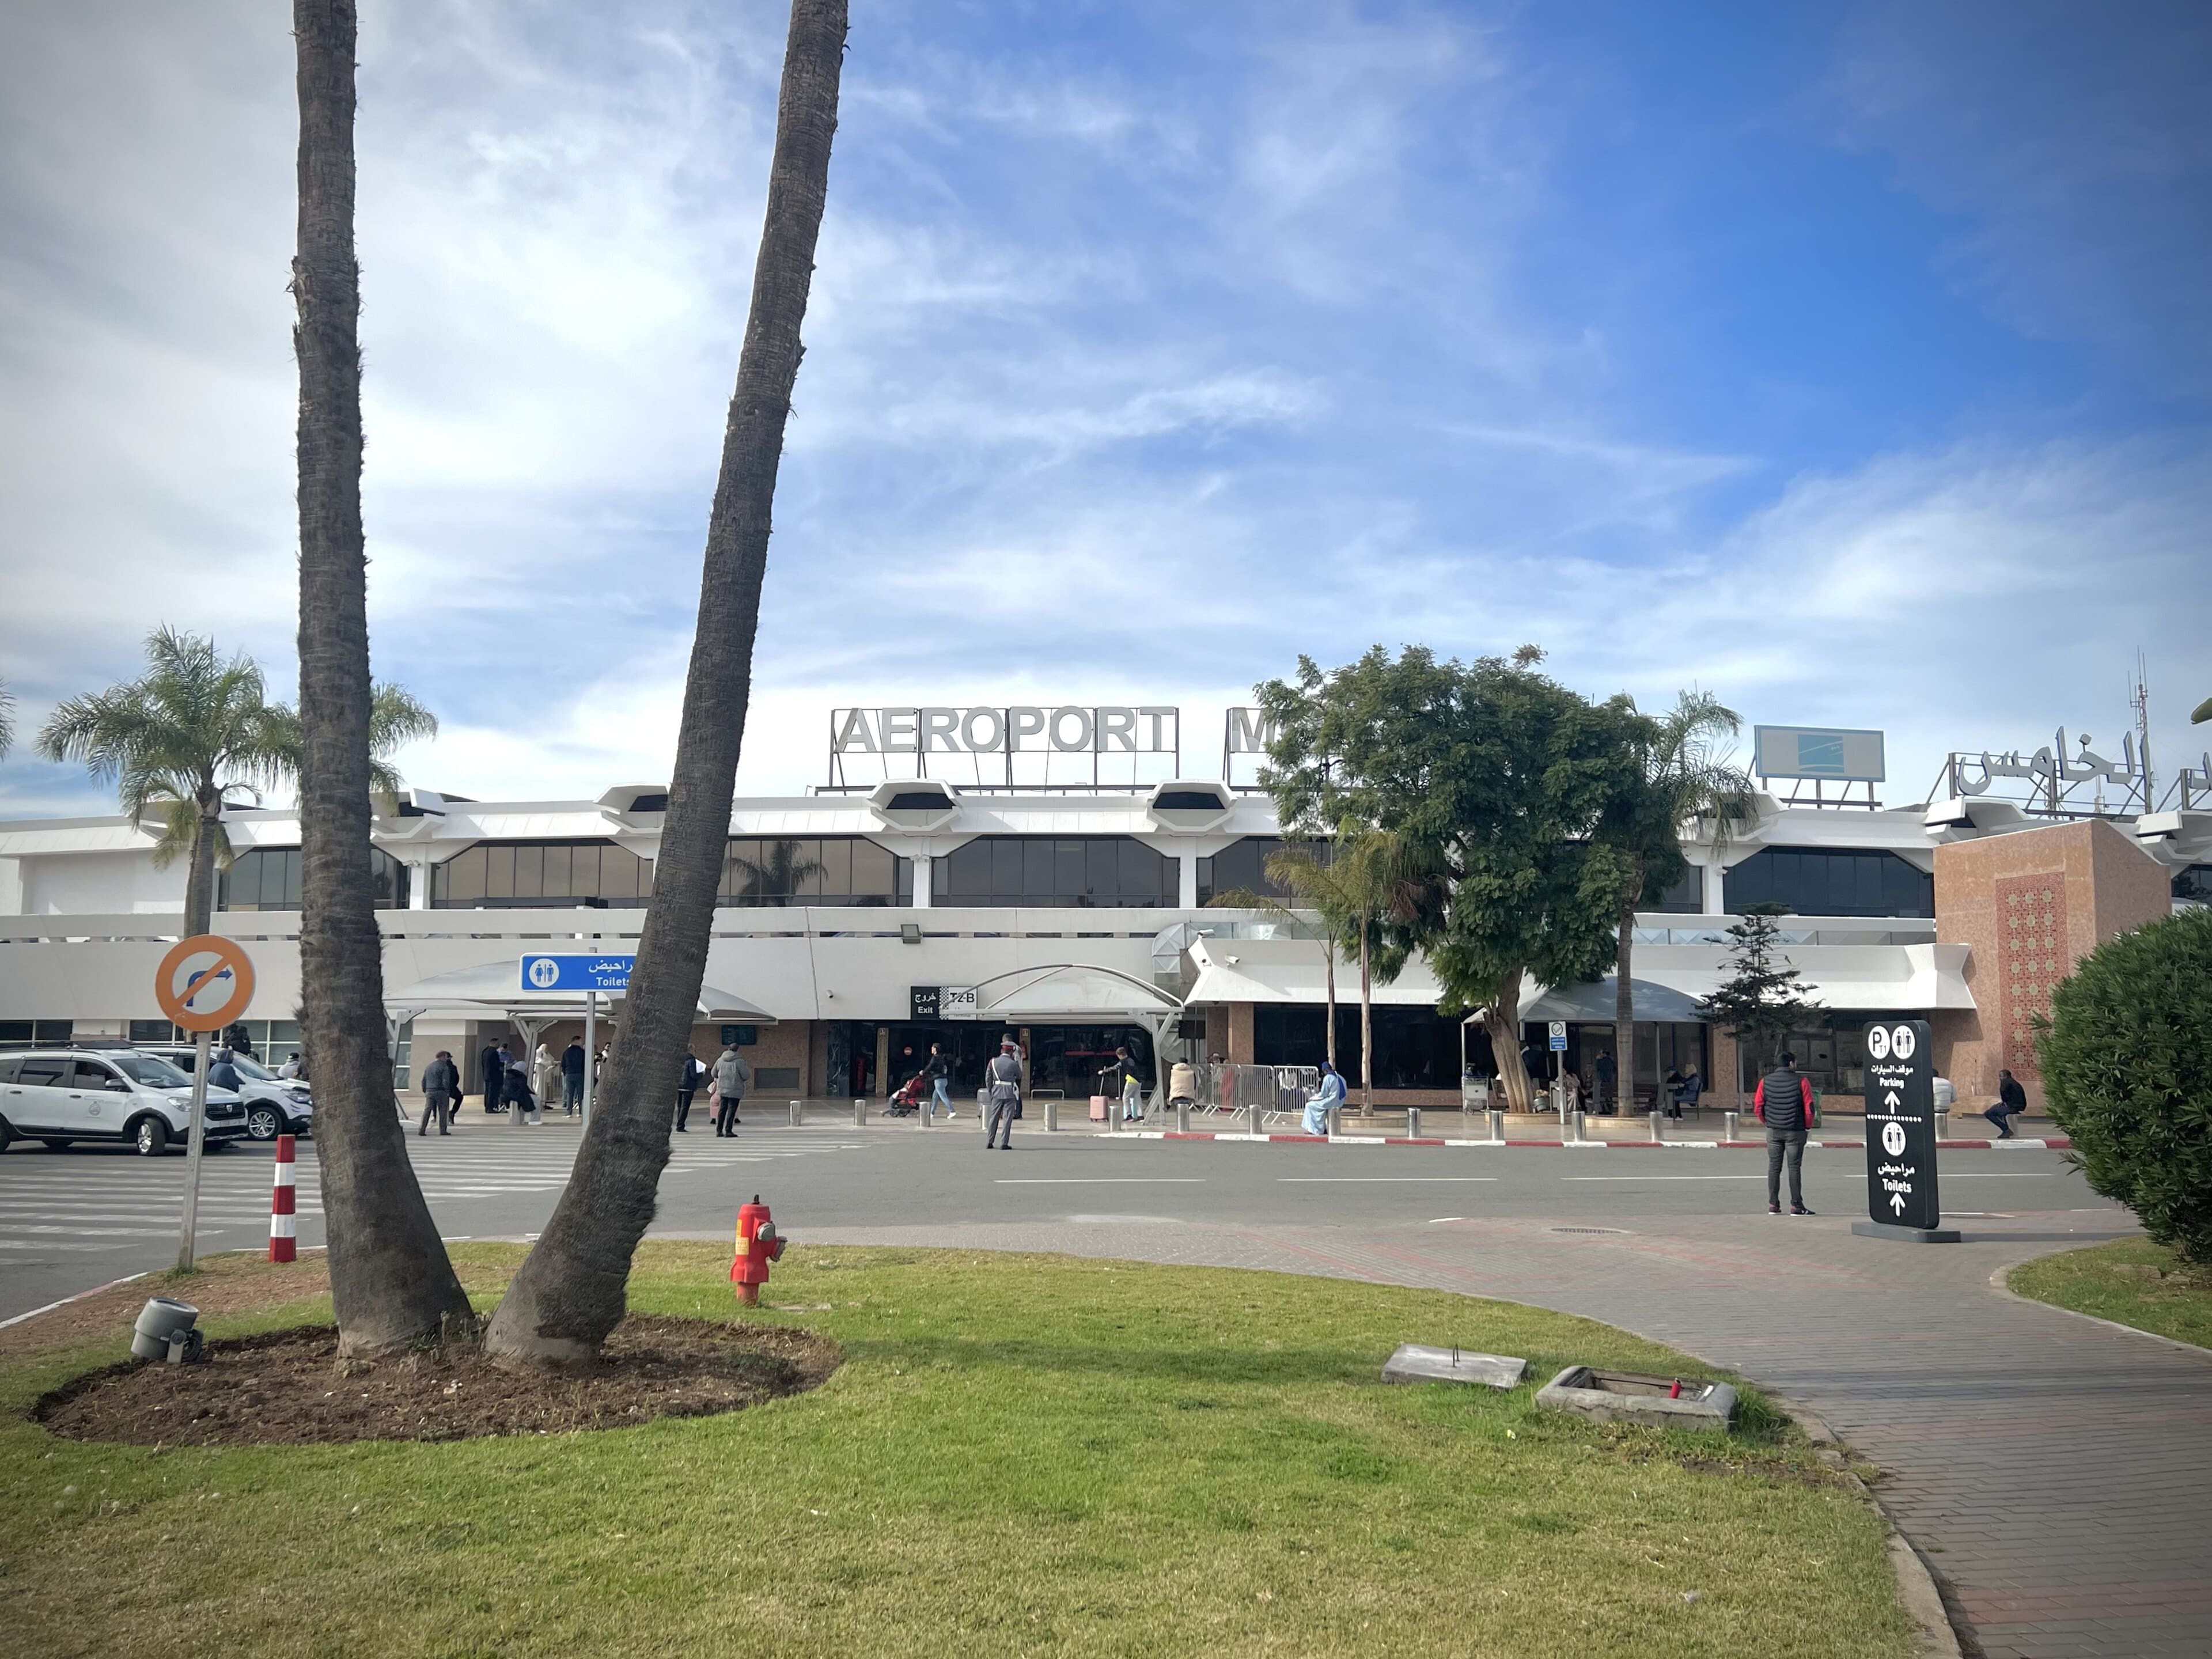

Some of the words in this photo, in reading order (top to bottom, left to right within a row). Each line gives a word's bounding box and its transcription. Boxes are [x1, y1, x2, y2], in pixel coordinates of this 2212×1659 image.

[833, 706, 1175, 753] AEROPORT
[1959, 726, 2151, 796] الخامس
[589, 960, 633, 973] راحيض
[915, 993, 937, 1003] خروج
[1878, 1045, 1887, 1054] T1
[1871, 1064, 1895, 1075] السيارات
[1895, 1064, 1914, 1075] موقف
[1880, 1077, 1904, 1089] Parking
[1878, 1162, 1915, 1177] مراحيض
[1882, 1178, 1912, 1193] Toilets
